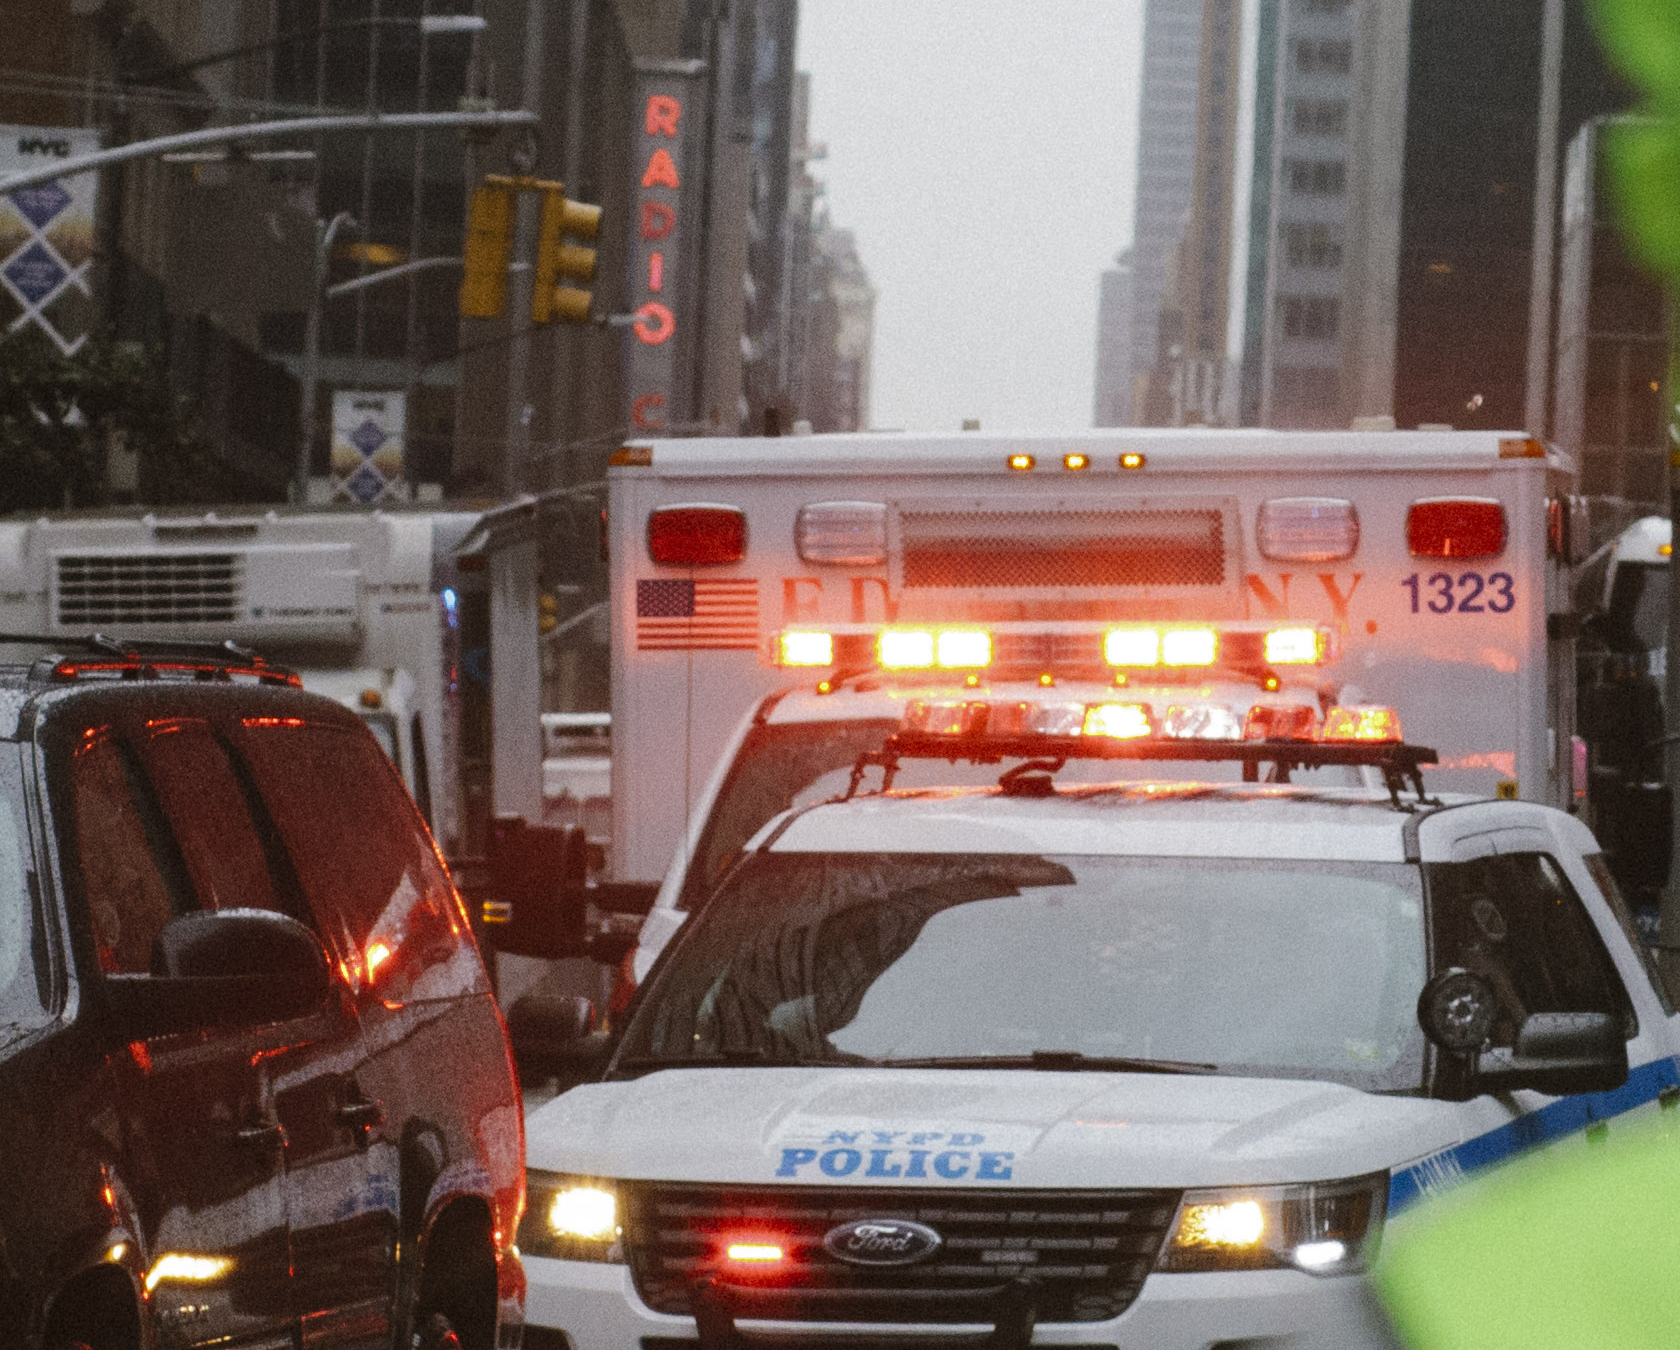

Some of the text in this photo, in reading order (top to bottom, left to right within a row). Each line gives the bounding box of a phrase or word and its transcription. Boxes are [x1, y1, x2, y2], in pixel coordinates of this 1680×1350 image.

[18, 138, 70, 157] NYC
[632, 94, 682, 345] RADIO
[1400, 571, 1516, 614] 1323
[822, 1129, 986, 1146] NYPD
[775, 1147, 1016, 1181] POLICE
[847, 1223, 913, 1252] Ford
